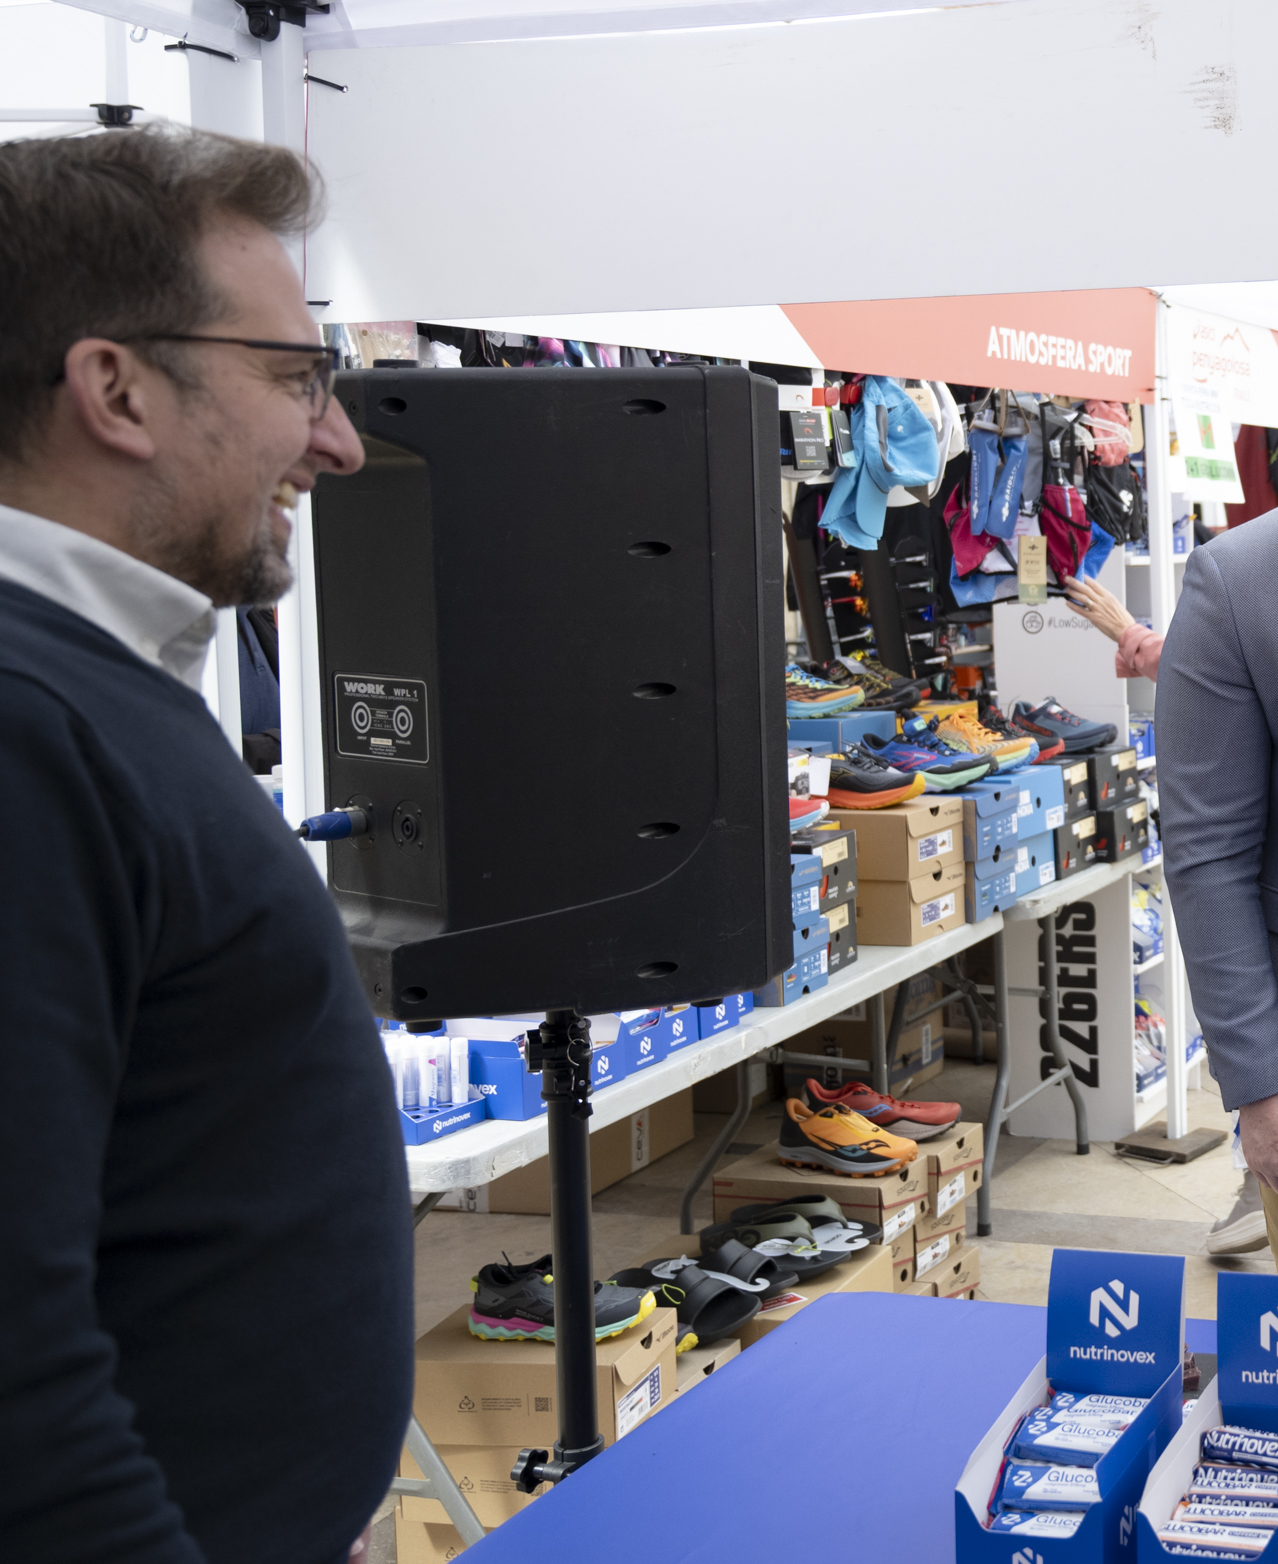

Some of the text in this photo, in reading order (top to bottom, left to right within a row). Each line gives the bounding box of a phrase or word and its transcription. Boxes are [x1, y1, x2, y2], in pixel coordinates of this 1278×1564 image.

[987, 325, 1132, 377] ATMOSFERA SPORT
[1192, 350, 1251, 378] penyagolosa
[344, 681, 385, 695] WORK
[393, 688, 418, 698] WPL 1
[1017, 803, 1034, 818] HOKA
[442, 1111, 471, 1128] nutrinovex
[1070, 1344, 1156, 1364] nutrinovex
[1048, 1469, 1098, 1484] Gluco
